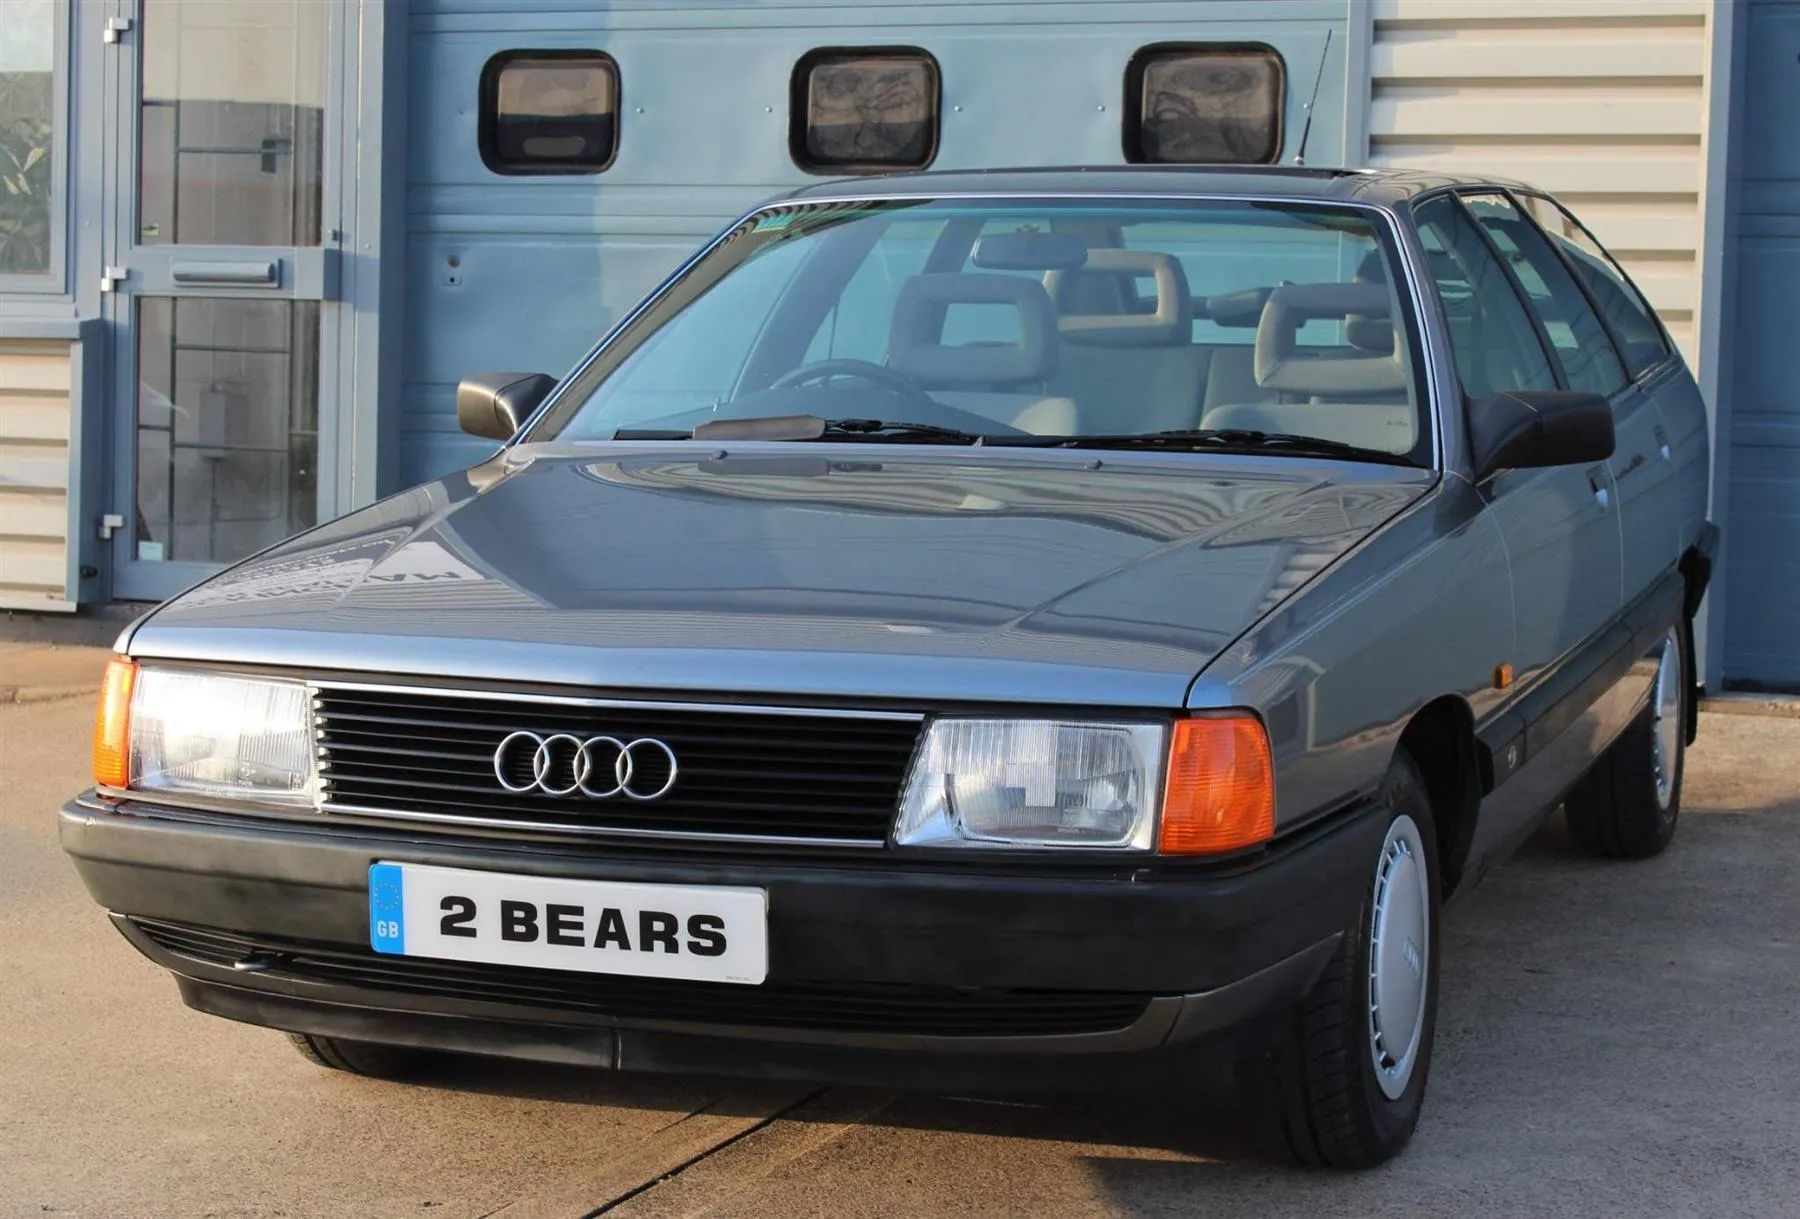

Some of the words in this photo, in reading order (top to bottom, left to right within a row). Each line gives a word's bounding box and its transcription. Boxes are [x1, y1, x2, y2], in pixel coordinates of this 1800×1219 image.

[377, 919, 399, 939] GB
[440, 895, 478, 939] 2
[500, 899, 728, 957] BEARS
